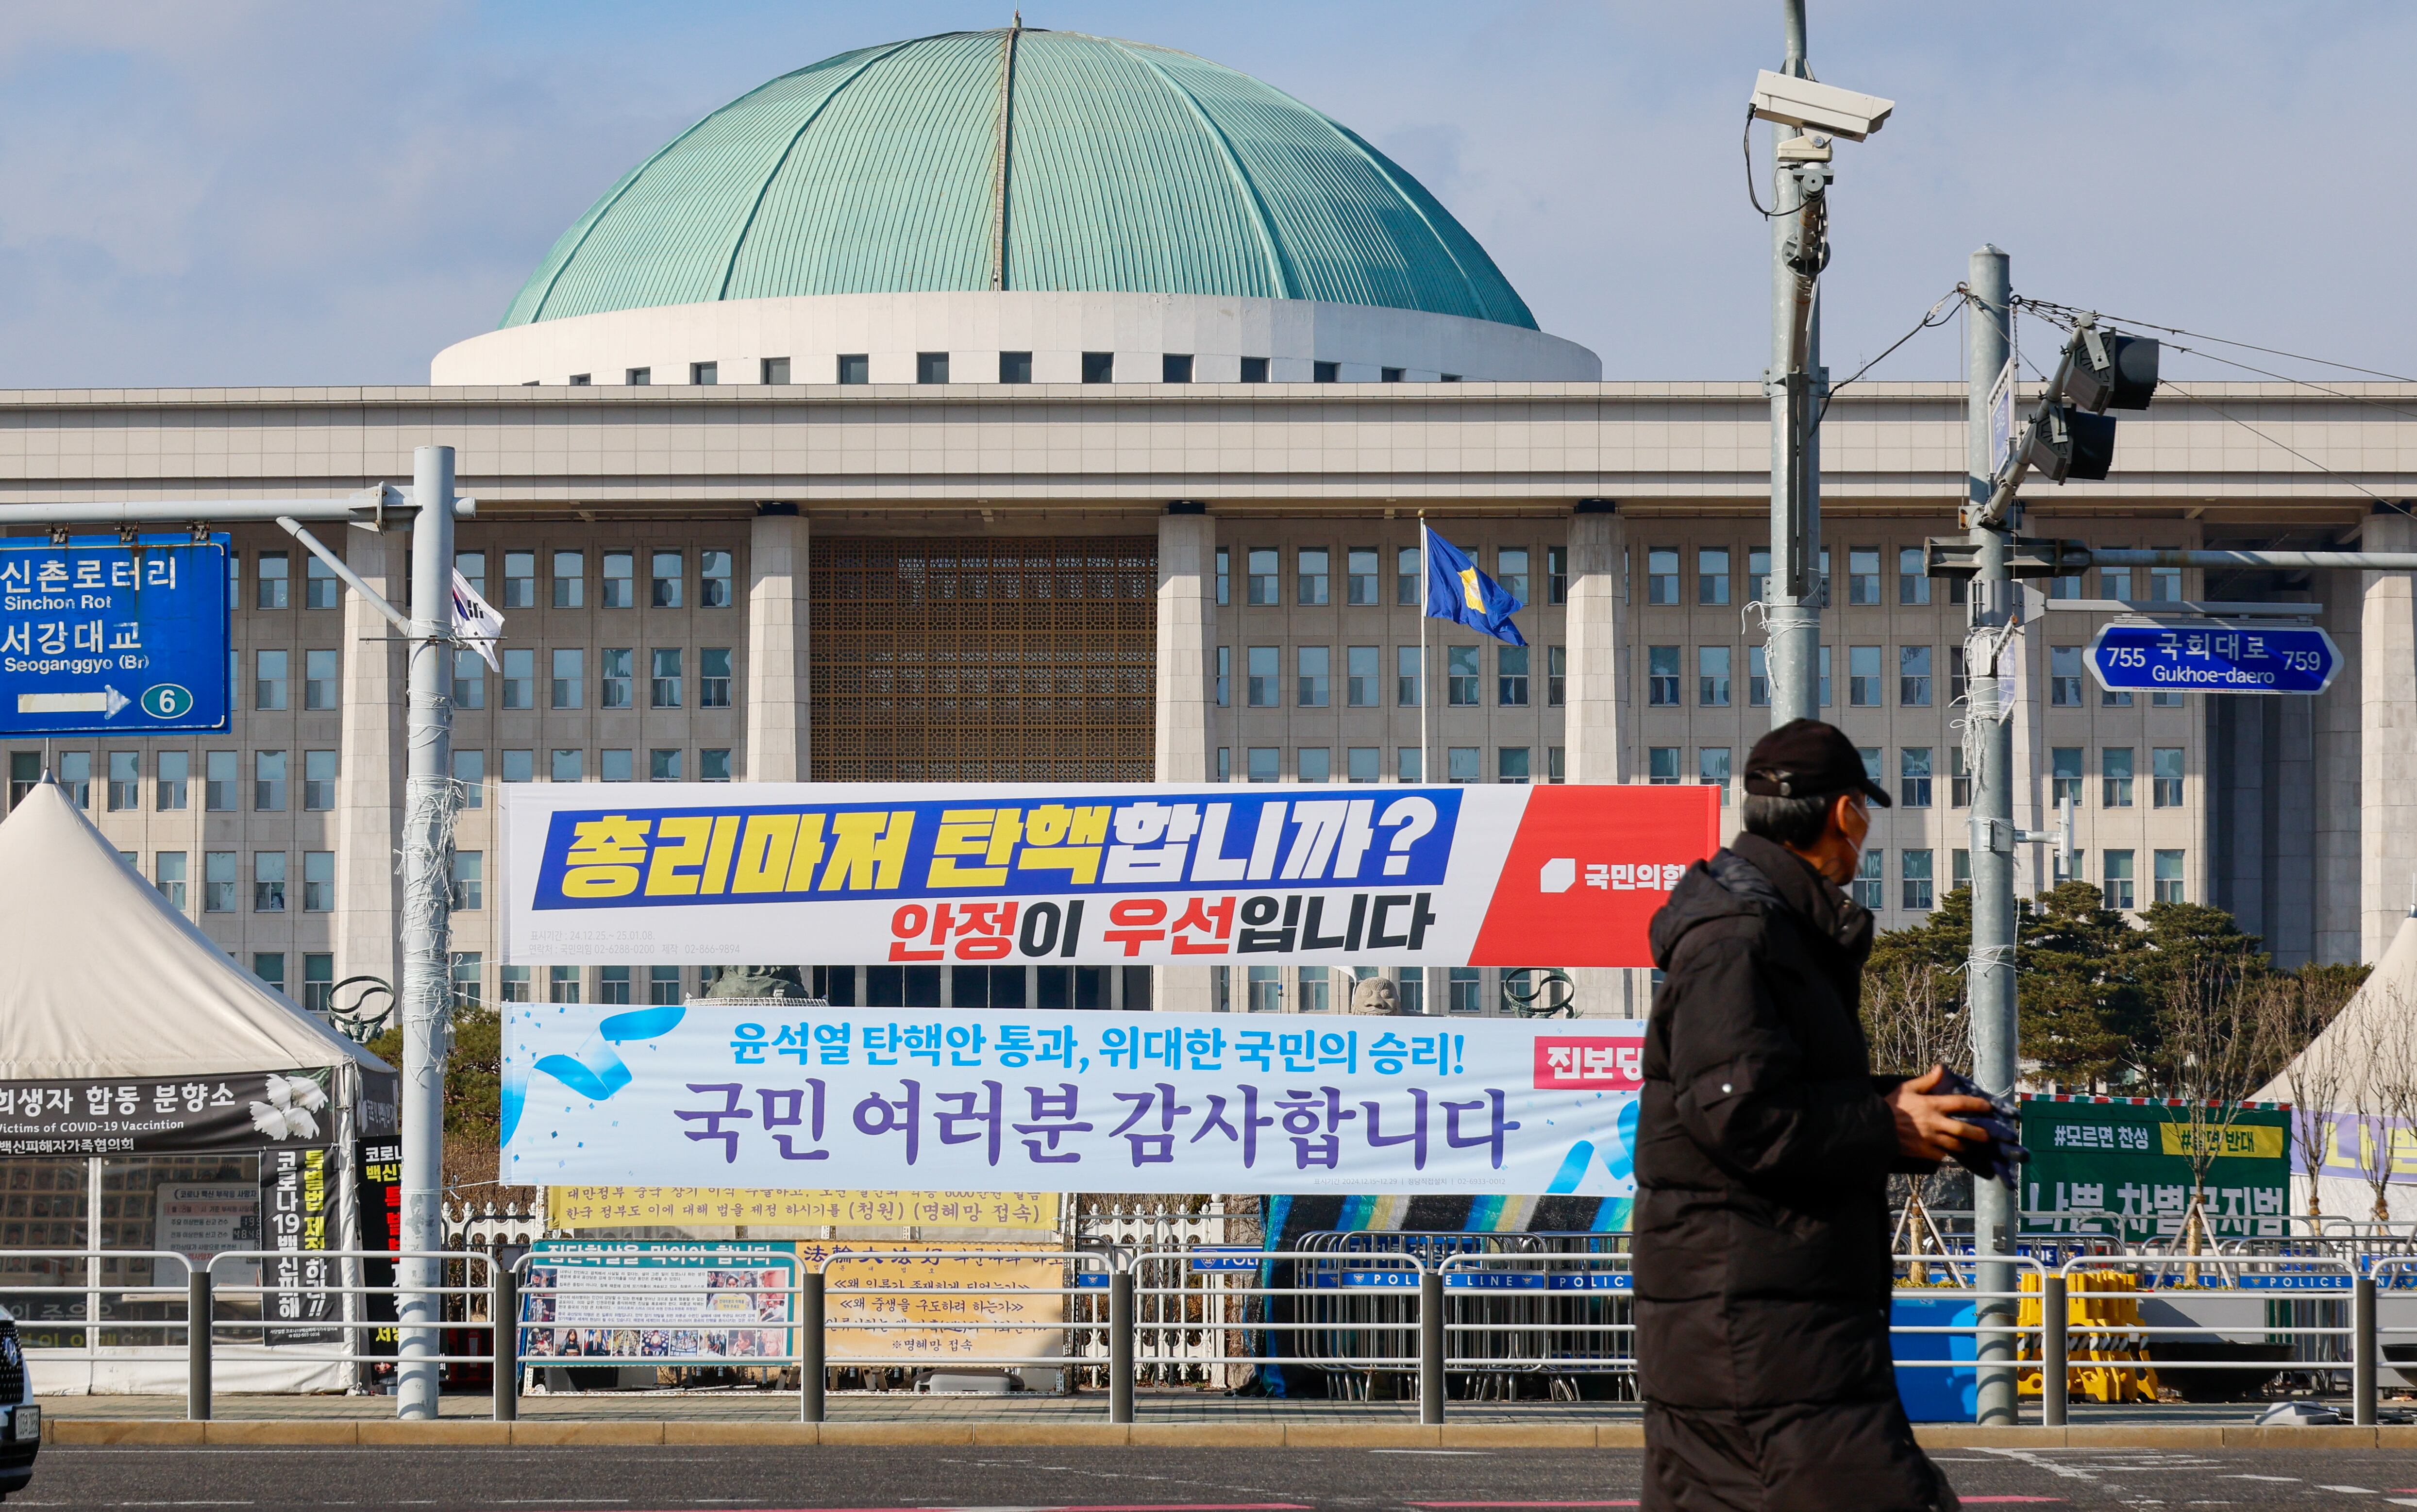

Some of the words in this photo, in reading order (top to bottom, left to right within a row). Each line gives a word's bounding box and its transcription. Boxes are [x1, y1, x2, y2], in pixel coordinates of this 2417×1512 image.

[0, 556, 176, 593] 신촌로터리
[4, 595, 75, 610] Sinchon
[81, 595, 112, 609] Rot
[0, 620, 142, 655] 서강대교
[2106, 647, 2146, 668] 755
[2156, 633, 2269, 661] 국회대로
[2282, 651, 2320, 671] 759
[4, 656, 113, 674] Seoganggyo
[2152, 666, 2275, 684] Gukhoe-daero
[159, 689, 176, 713] 6
[561, 811, 916, 898] 총리마저
[926, 796, 1437, 888] 탄핵합니까?
[531, 931, 562, 941] 표시기간
[888, 900, 1085, 962] 안정이
[1103, 892, 1436, 957] 우선입니다
[528, 944, 553, 955] 연락처
[560, 944, 592, 955] 국민의힘
[594, 945, 655, 954] 02-6288-0200
[662, 944, 679, 955] 제작
[685, 944, 740, 954] 02-866-9894
[730, 1022, 850, 1065] 윤석열
[862, 1023, 987, 1067] 탄핵안
[994, 1024, 1090, 1074] 통과,
[1099, 1025, 1226, 1072] 위대한
[1235, 1028, 1358, 1074] 국민의
[1368, 1031, 1464, 1076] 승리!
[86, 1085, 141, 1115] 합동
[153, 1082, 236, 1113] 분향소
[43, 1123, 56, 1133] of
[60, 1122, 118, 1133] COVID-19
[121, 1119, 184, 1131] Vaccintion
[673, 1077, 830, 1164] 국민
[853, 1077, 1093, 1167] 여러분
[1109, 1082, 1521, 1171] 감사합니다
[2054, 1124, 2114, 1148] #모르면
[2117, 1126, 2148, 1150] 찬성
[2225, 1130, 2254, 1153] 반대
[180, 1190, 199, 1198] 코로나
[566, 1206, 593, 1220] 한국
[601, 1204, 641, 1219] 정부도
[648, 1203, 673, 1217] 이에
[683, 1203, 708, 1217] 대해
[717, 1203, 744, 1217] 법을
[751, 1203, 776, 1217] 제정
[786, 1203, 840, 1218] 하시기를
[849, 1201, 904, 1221] (청원)
[990, 1202, 1040, 1224] 접속)
[2269, 1277, 2342, 1287] POLICE
[872, 1297, 910, 1312] 중생을
[915, 1299, 966, 1313] 구도하려
[948, 1338, 973, 1352] 접속
